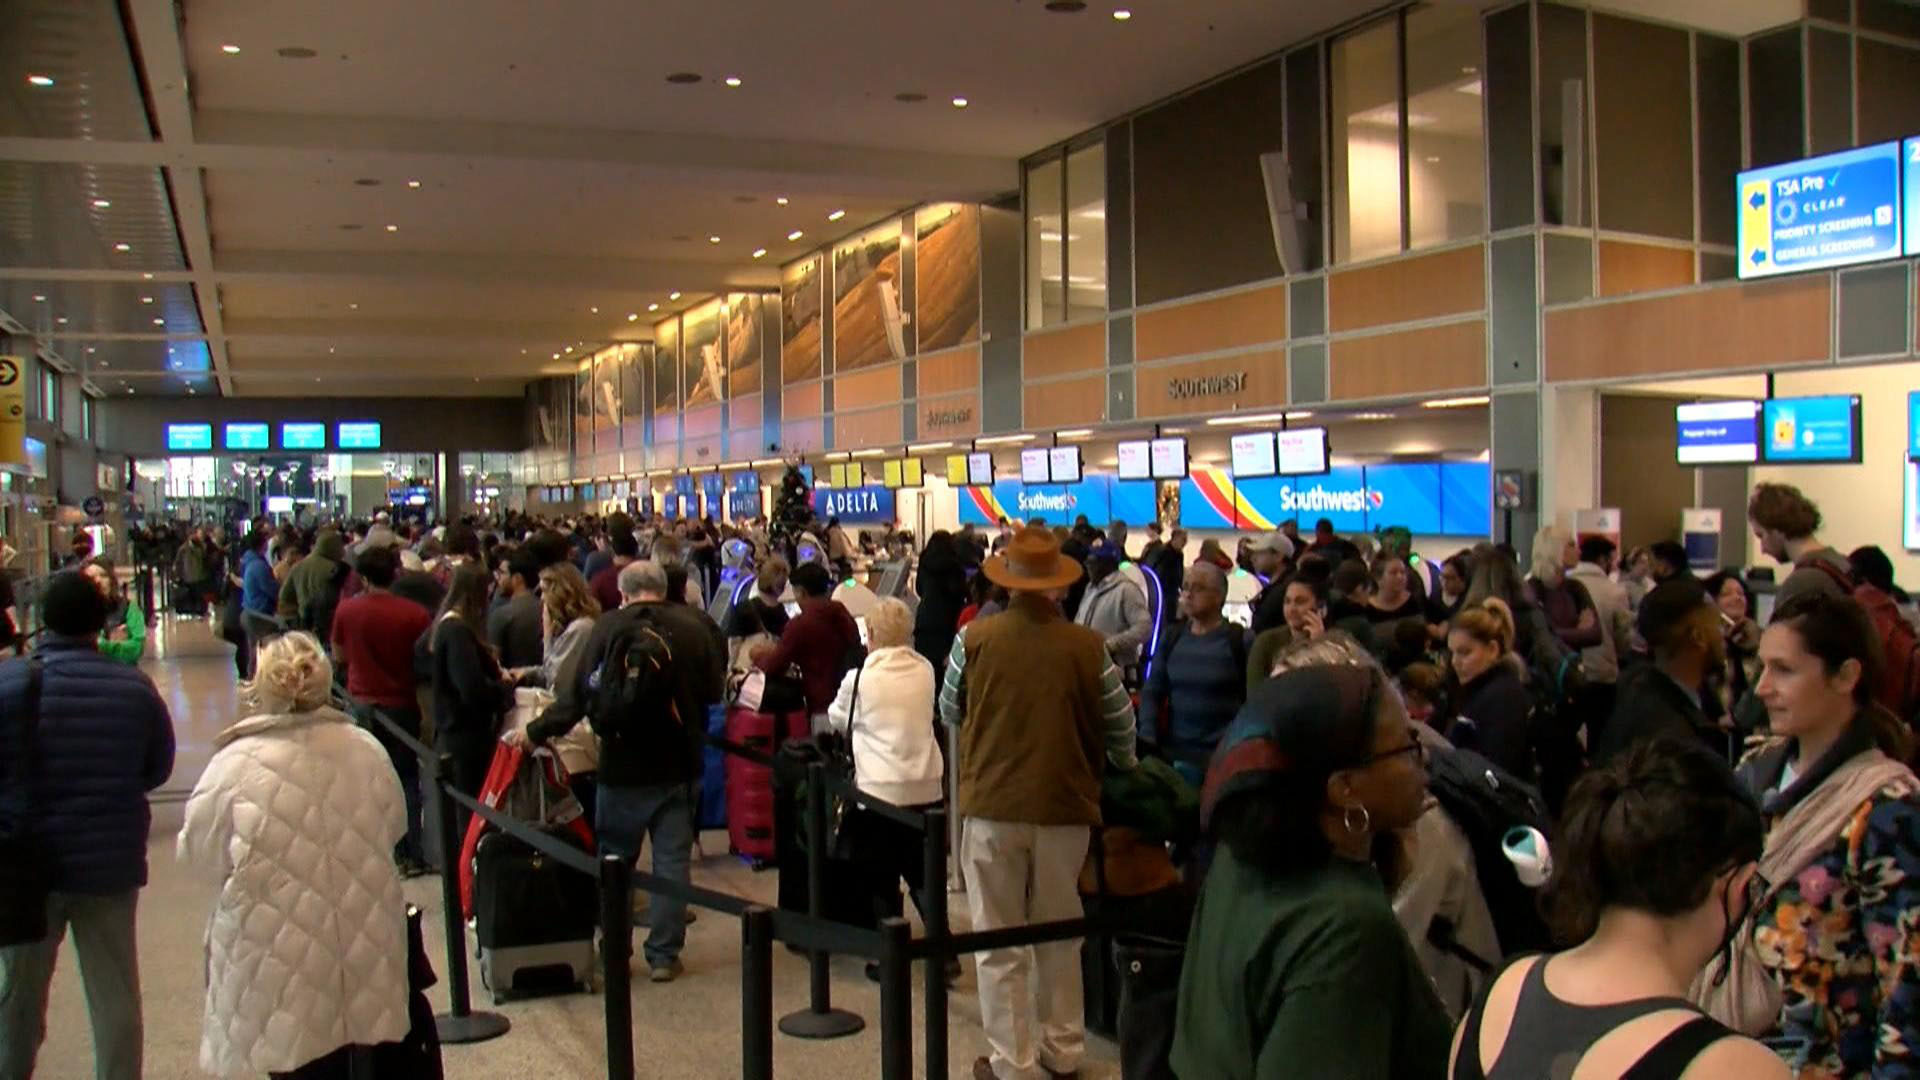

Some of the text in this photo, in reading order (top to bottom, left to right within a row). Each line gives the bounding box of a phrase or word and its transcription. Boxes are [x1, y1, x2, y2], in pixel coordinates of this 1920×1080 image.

[1776, 176, 1824, 196] TSA Pre
[1803, 197, 1845, 213] CLEAR
[1774, 215, 1872, 240] PRIORITY SCREENING
[1775, 237, 1875, 261] GENERAL SCREENING
[1168, 372, 1247, 399] SOUTHWEST
[837, 491, 879, 513] DELTA
[1018, 491, 1070, 512] Southwest
[1280, 484, 1371, 513] Southwest
